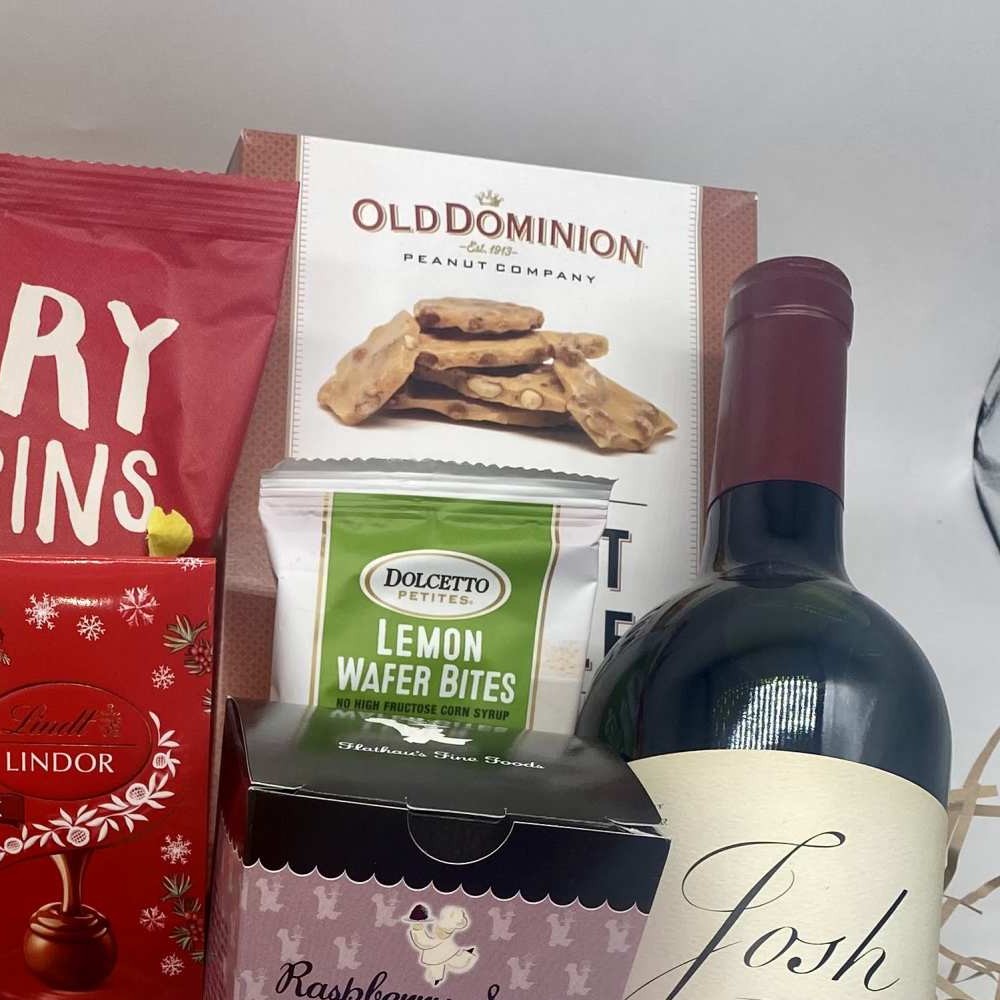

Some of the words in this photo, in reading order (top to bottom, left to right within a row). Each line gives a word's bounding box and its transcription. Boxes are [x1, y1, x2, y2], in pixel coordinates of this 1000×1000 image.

[352, 197, 441, 234] OLD
[444, 202, 644, 268] DOMINION
[403, 253, 488, 271] PEANUT
[495, 262, 597, 284] COMPANY
[383, 567, 490, 594] DOLCETTO
[397, 590, 469, 605] PETITES
[376, 618, 483, 662] LEMON
[337, 655, 432, 697] WAFER
[439, 663, 517, 704] BITES
[0, 703, 97, 738] Lindt
[336, 697, 350, 710] NO
[354, 699, 380, 712] HIGH
[383, 701, 438, 715] FRUCTOSE
[440, 704, 470, 718] CORN
[473, 707, 510, 721] SYRUP
[6, 751, 115, 773] LINDOR
[434, 749, 479, 763] Fine
[484, 755, 545, 770] Foods
